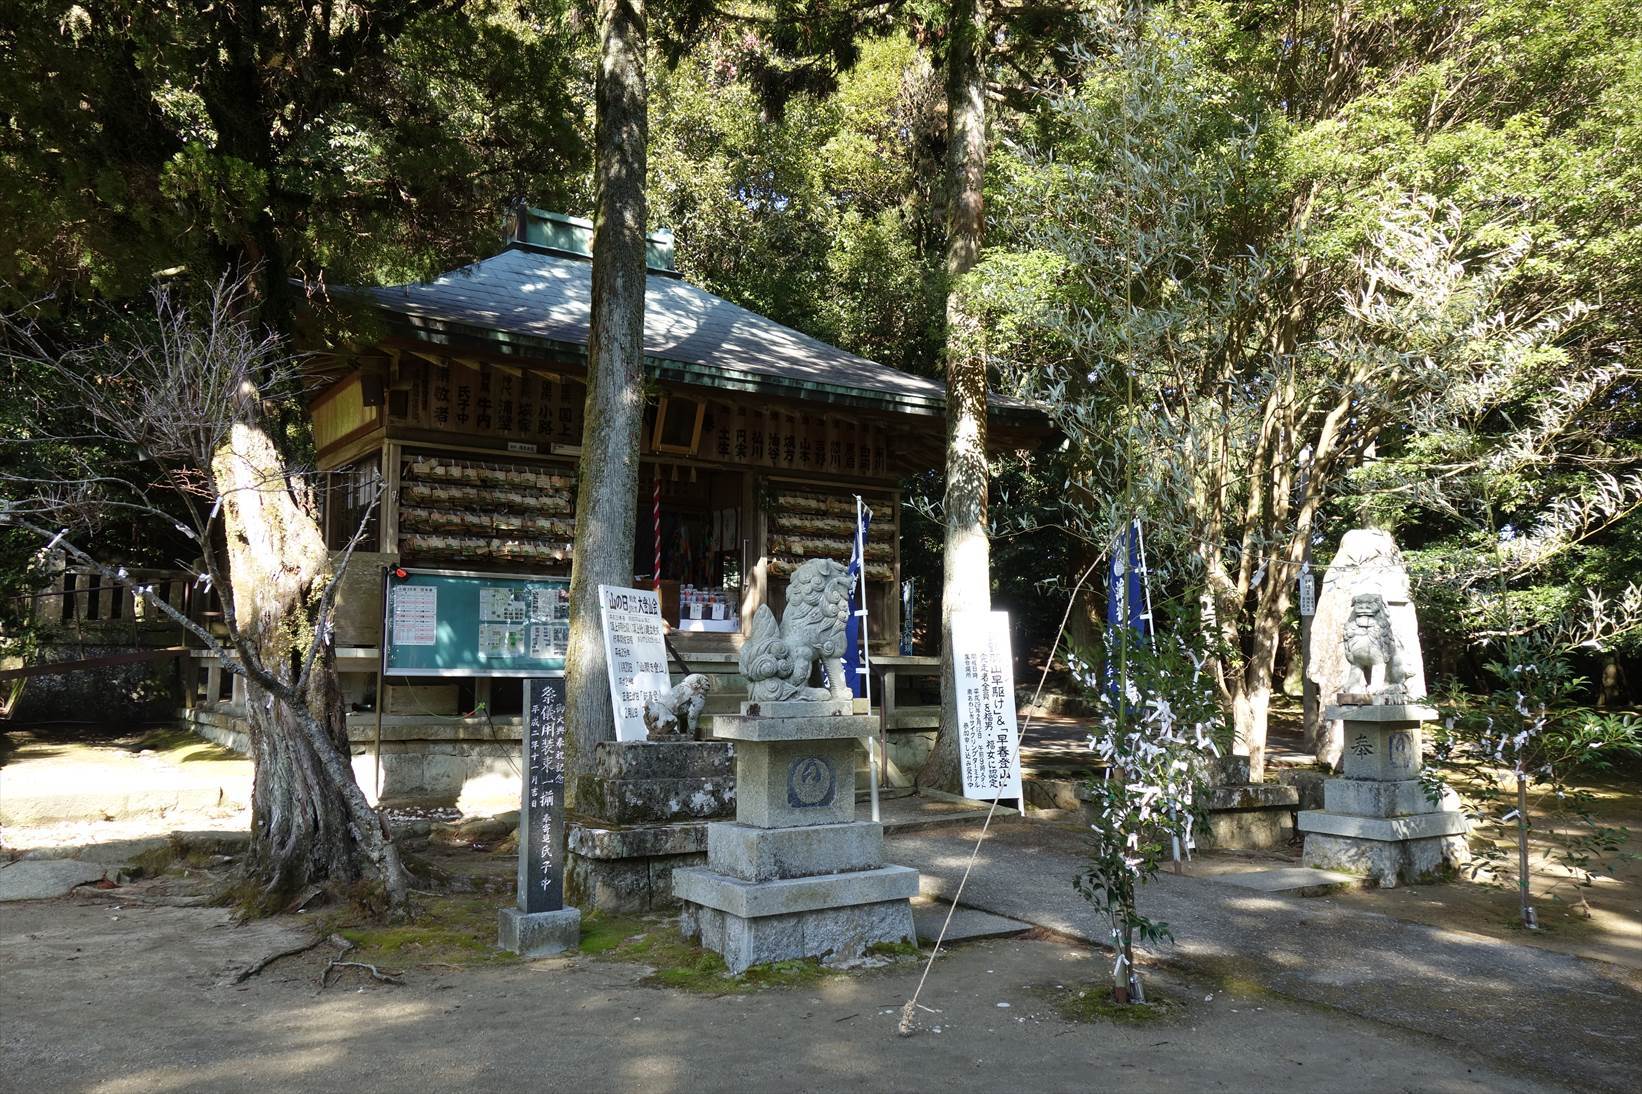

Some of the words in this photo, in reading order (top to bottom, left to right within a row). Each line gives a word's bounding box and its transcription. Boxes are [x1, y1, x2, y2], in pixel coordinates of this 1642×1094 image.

[457, 385, 471, 424] 氏子中
[530, 704, 540, 808] 平成二年十一月吉日
[1351, 733, 1374, 761] 奉
